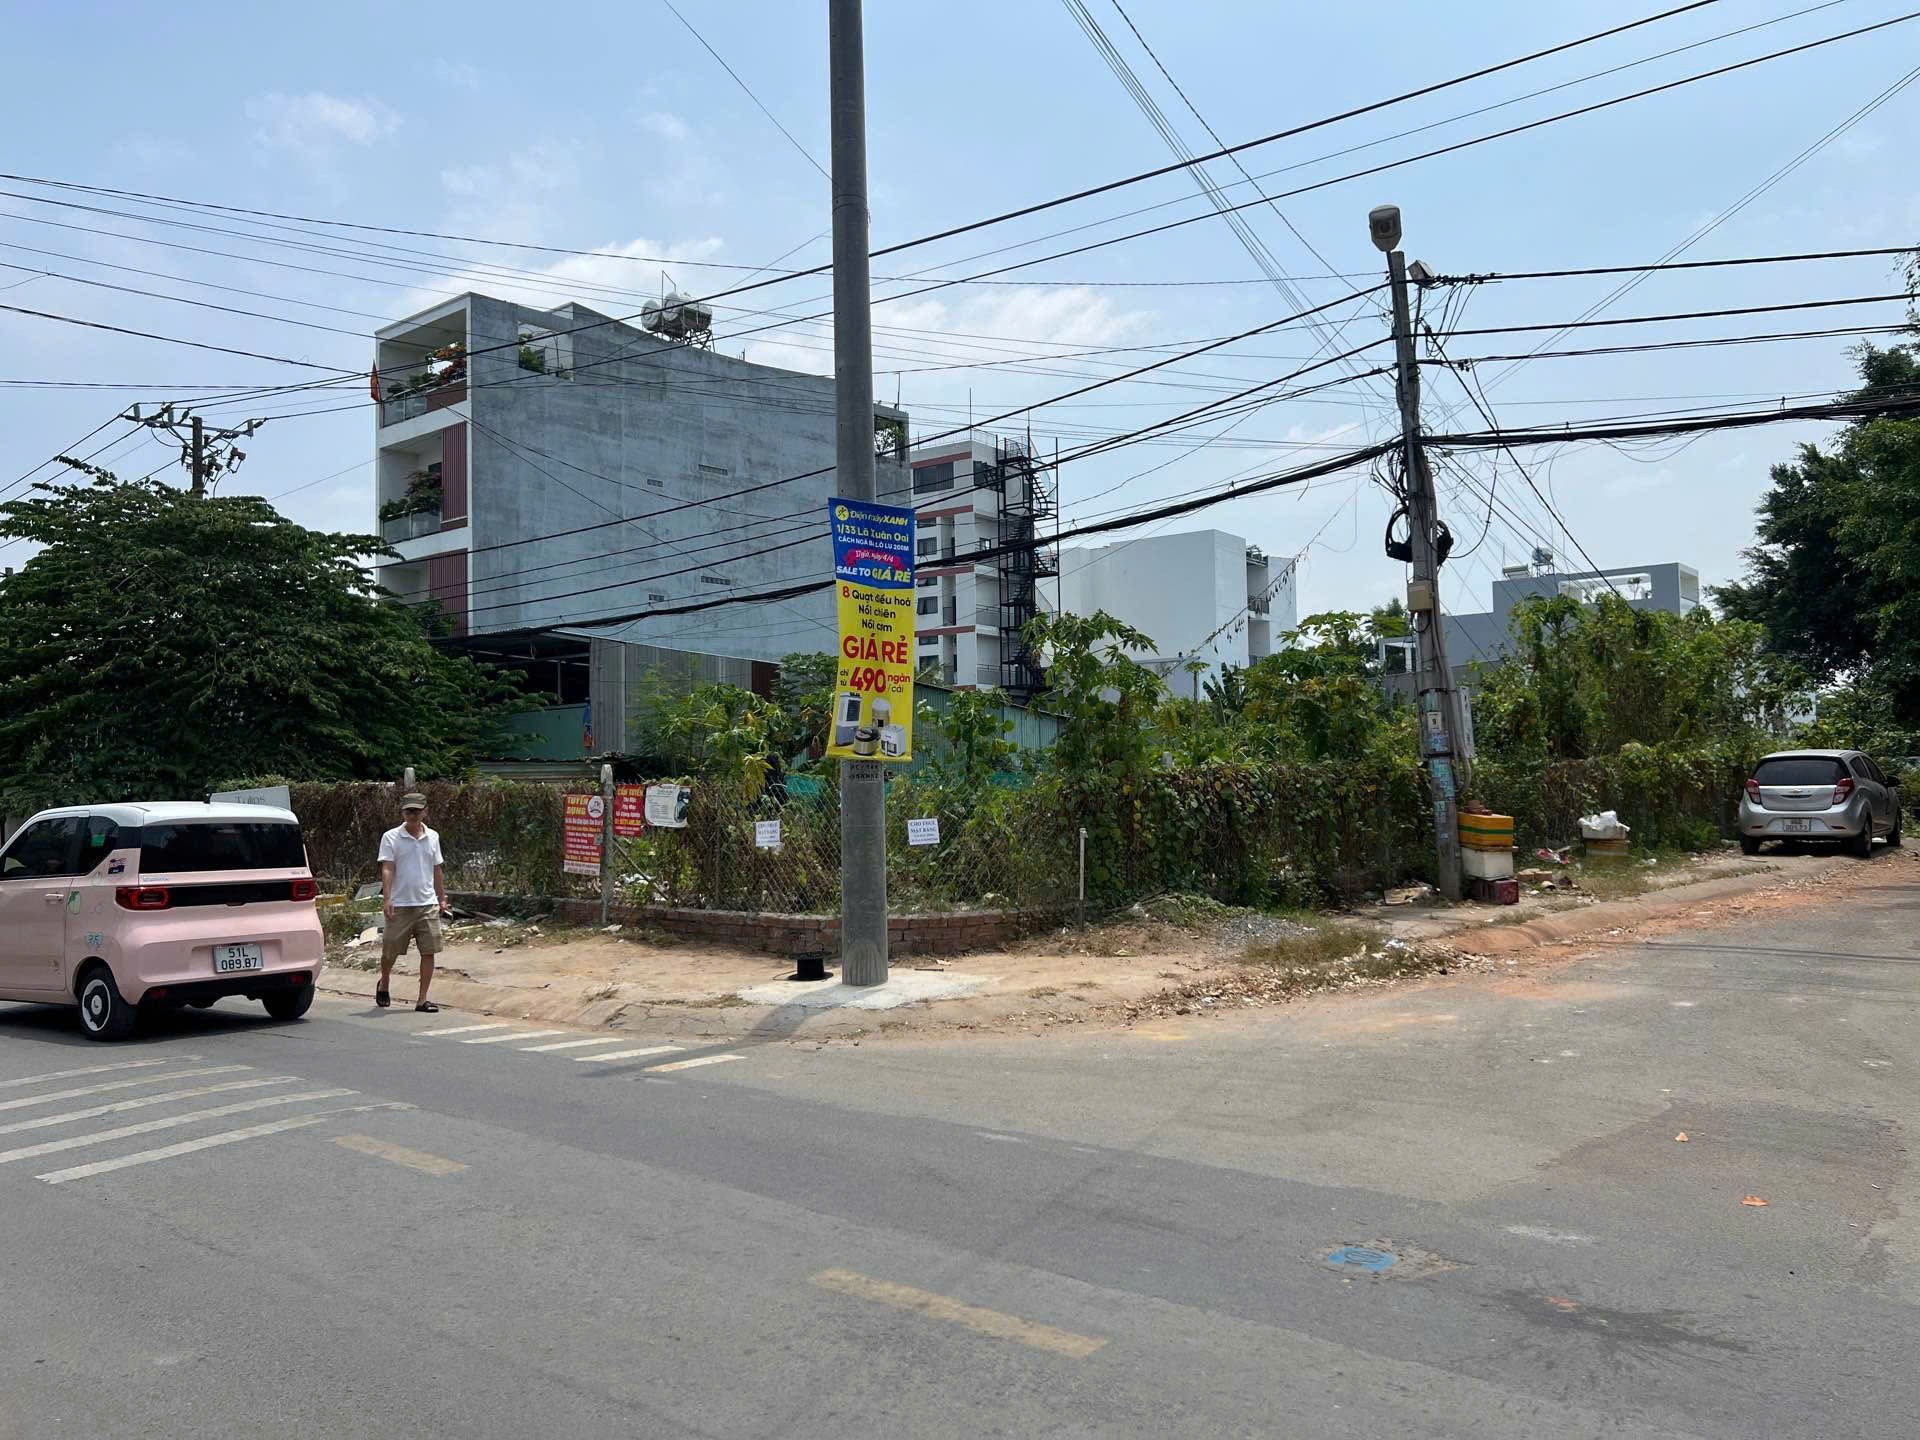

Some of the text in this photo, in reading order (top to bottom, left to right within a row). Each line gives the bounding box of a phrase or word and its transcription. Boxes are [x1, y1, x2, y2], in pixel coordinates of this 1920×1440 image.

[883, 516, 908, 526] XANH
[837, 524, 856, 534] 1/33
[870, 528, 892, 540] Xuân
[894, 532, 908, 542] Oai
[838, 535, 854, 543] CÁCH
[836, 566, 912, 582] SALE TO GIÁ RẺ
[842, 586, 850, 598] 8
[852, 590, 873, 604] Quạt
[858, 604, 896, 618] Nồi chiên
[862, 618, 874, 630] Nồi
[843, 633, 908, 664] GIÁ RẺ
[850, 666, 886, 694] 490
[888, 673, 910, 684] ngàn
[228, 948, 248, 958] 51L
[221, 957, 257, 970] 089.87
